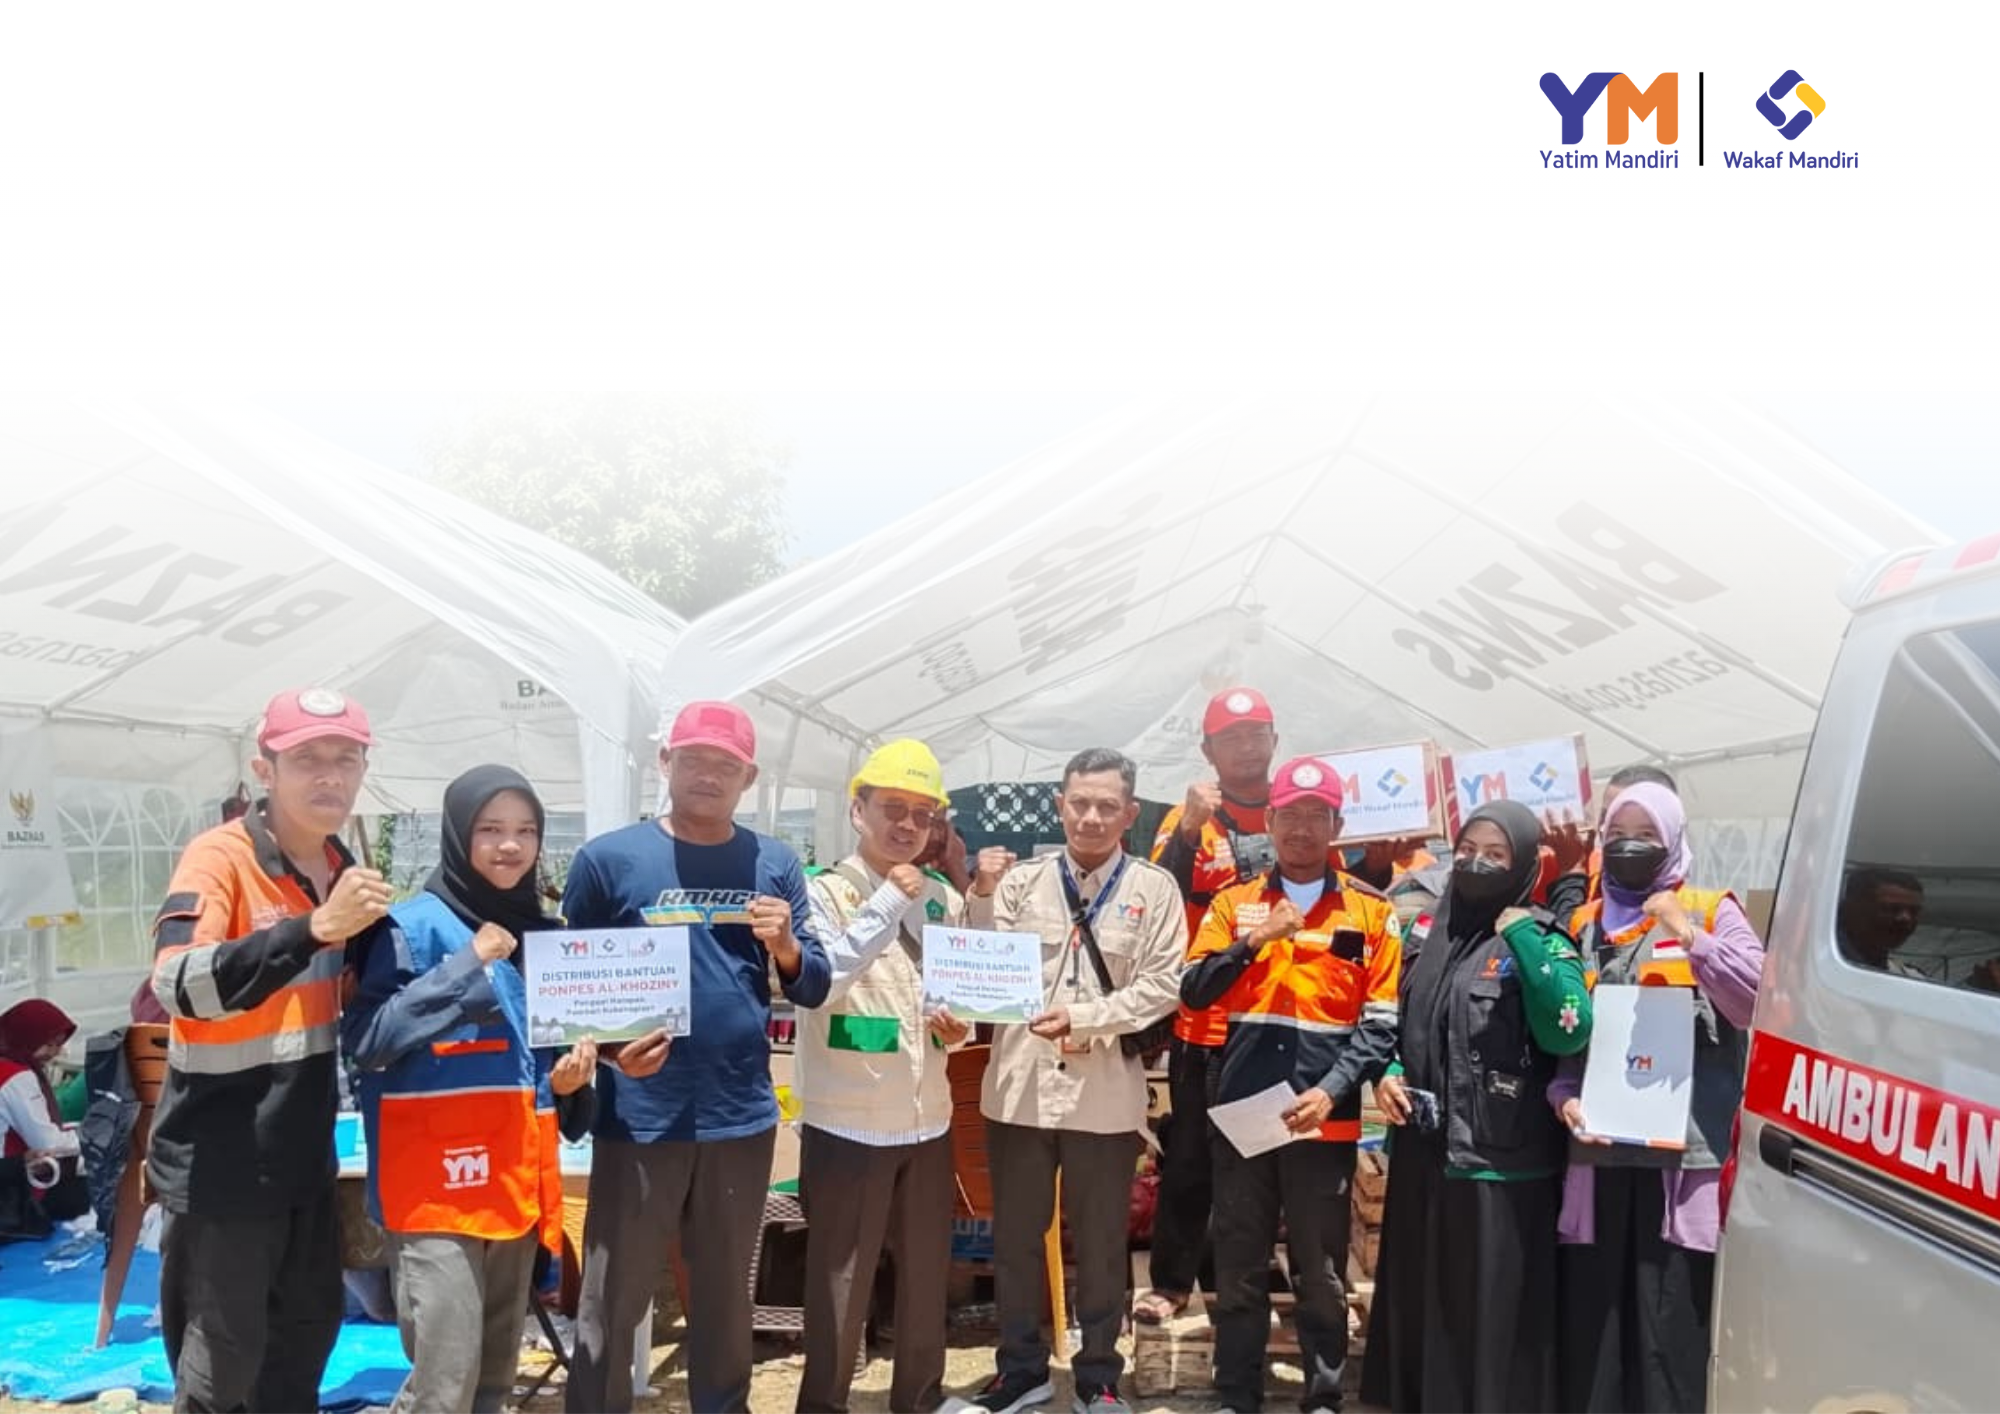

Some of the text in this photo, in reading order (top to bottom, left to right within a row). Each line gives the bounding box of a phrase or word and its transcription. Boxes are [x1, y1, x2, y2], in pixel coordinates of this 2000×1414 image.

[1460, 772, 1508, 805] YM
[560, 941, 589, 956] YM
[542, 966, 676, 983] DISTRIBUSI BANTUAN
[538, 984, 595, 997] PONPES
[1782, 1053, 2000, 1200] AMBULAN
[442, 1152, 489, 1183] YM
